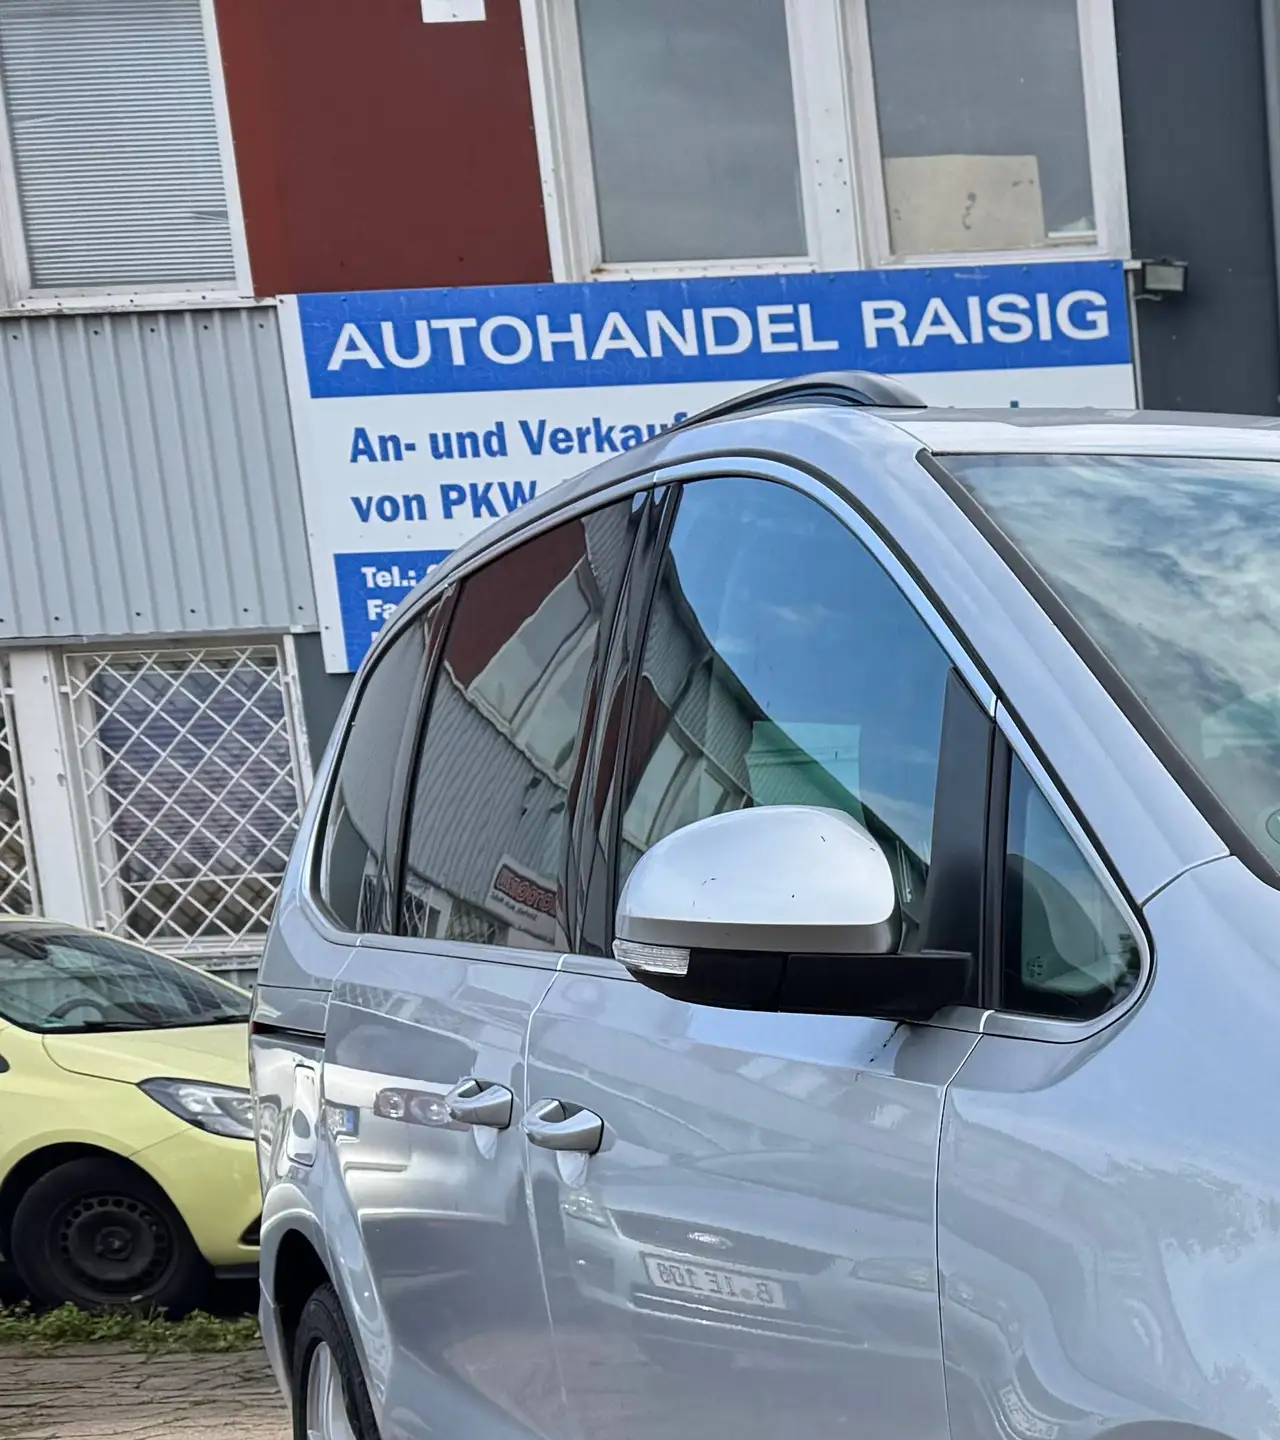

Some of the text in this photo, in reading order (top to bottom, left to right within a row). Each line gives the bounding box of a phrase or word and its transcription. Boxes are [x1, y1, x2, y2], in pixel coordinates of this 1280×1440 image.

[328, 289, 1111, 372] AUTOHANDEL RAISIG
[350, 427, 416, 463] An-
[429, 421, 508, 460] und
[351, 480, 537, 523] von PKW
[361, 565, 417, 588] Tel.:
